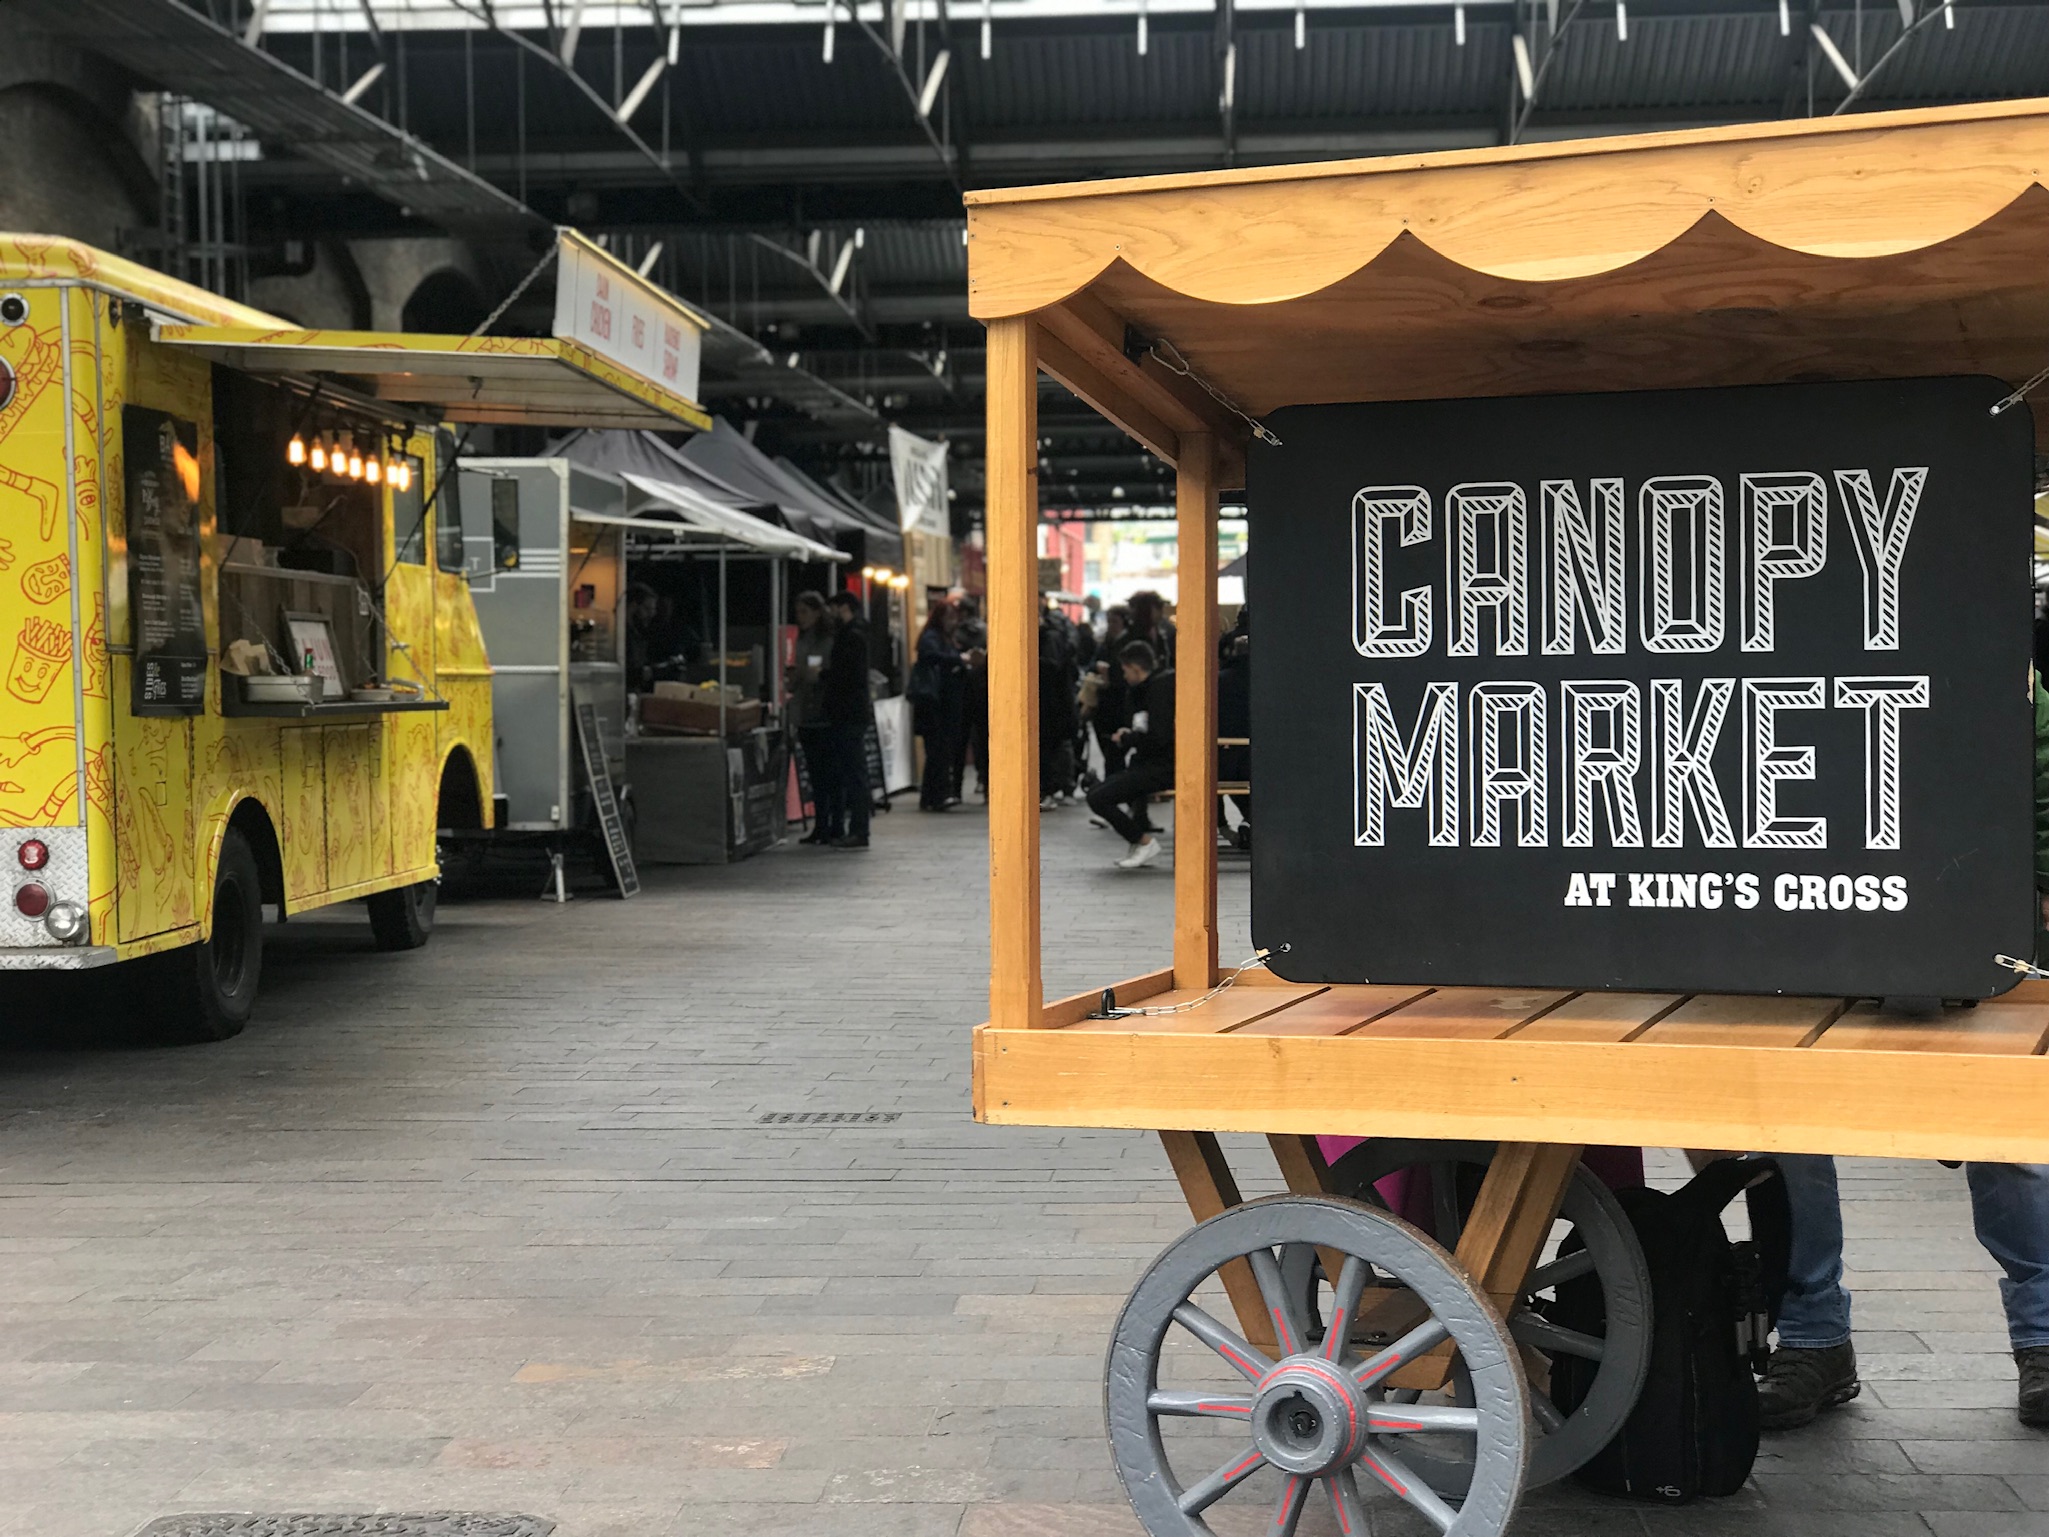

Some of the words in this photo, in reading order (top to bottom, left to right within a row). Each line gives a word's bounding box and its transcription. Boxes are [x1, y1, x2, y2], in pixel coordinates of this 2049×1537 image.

[1352, 467, 1928, 657] CANOPY
[1353, 676, 1929, 849] MARKET
[1564, 873, 1616, 907] AT
[1629, 873, 1760, 910] KING'S
[1774, 874, 1909, 912] CROSS
